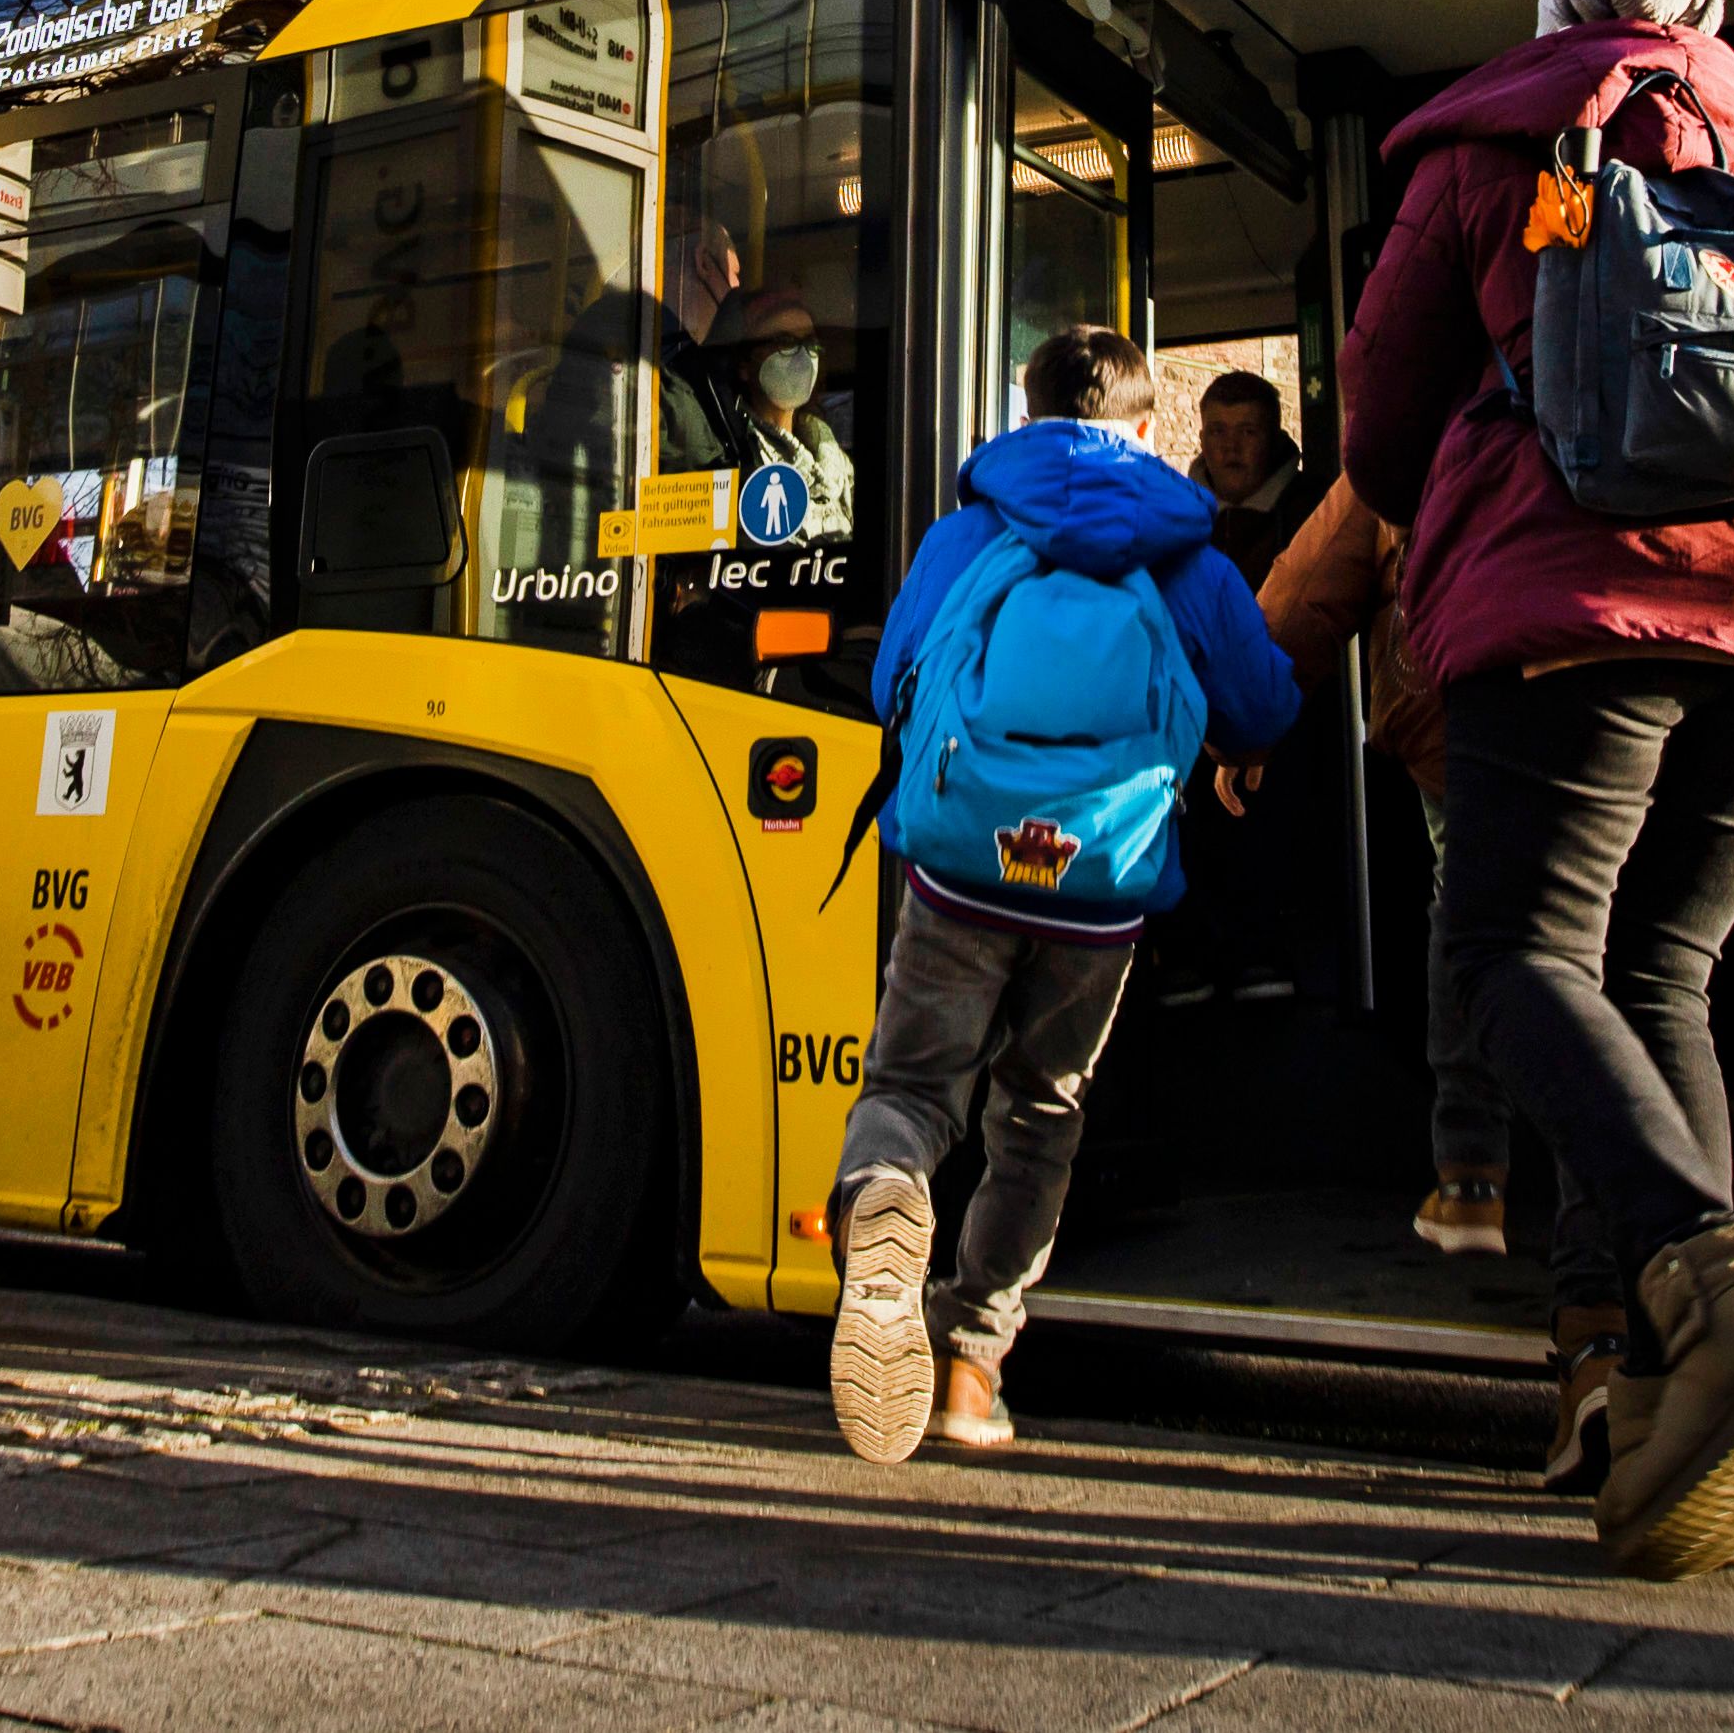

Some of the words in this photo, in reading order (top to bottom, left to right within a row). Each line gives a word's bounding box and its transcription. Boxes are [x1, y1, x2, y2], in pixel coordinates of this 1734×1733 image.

[135, 26, 204, 60] Platz
[644, 481, 709, 496] Beförderung
[713, 480, 730, 491] nur
[10, 504, 44, 531] BVG
[642, 501, 659, 513] mit
[663, 498, 710, 514] gültigem
[642, 514, 707, 529] Fahrausweis
[490, 564, 620, 604] Urbino
[32, 868, 90, 911] BVG
[22, 960, 75, 993] VBB
[778, 1033, 861, 1086] BVG
